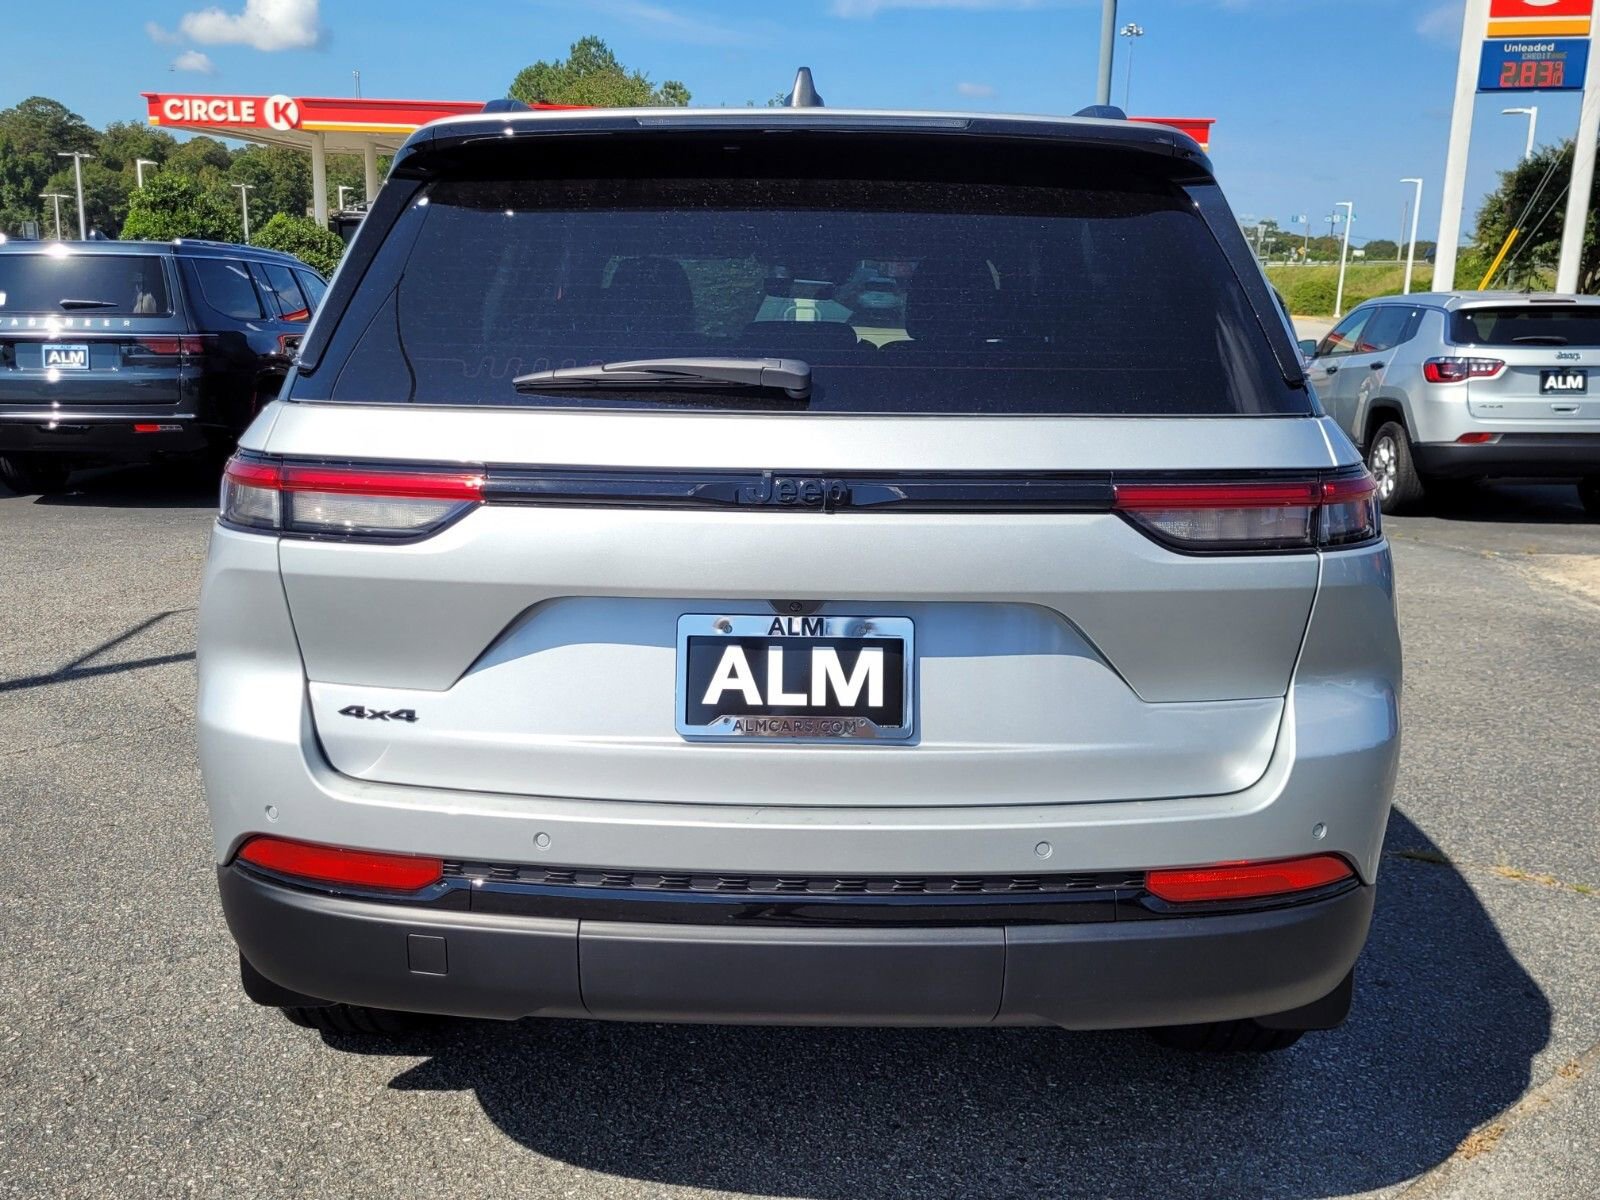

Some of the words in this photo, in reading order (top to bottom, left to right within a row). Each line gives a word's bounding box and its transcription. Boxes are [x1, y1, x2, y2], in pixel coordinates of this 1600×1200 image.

[1504, 43, 1555, 52] Unleaded
[163, 98, 256, 123] CIRCLE
[273, 102, 296, 128] K
[48, 351, 84, 363] ALM
[1544, 375, 1583, 389] ALM
[746, 470, 849, 514] Jeep
[768, 617, 825, 637] ALM
[702, 645, 884, 707] ALM
